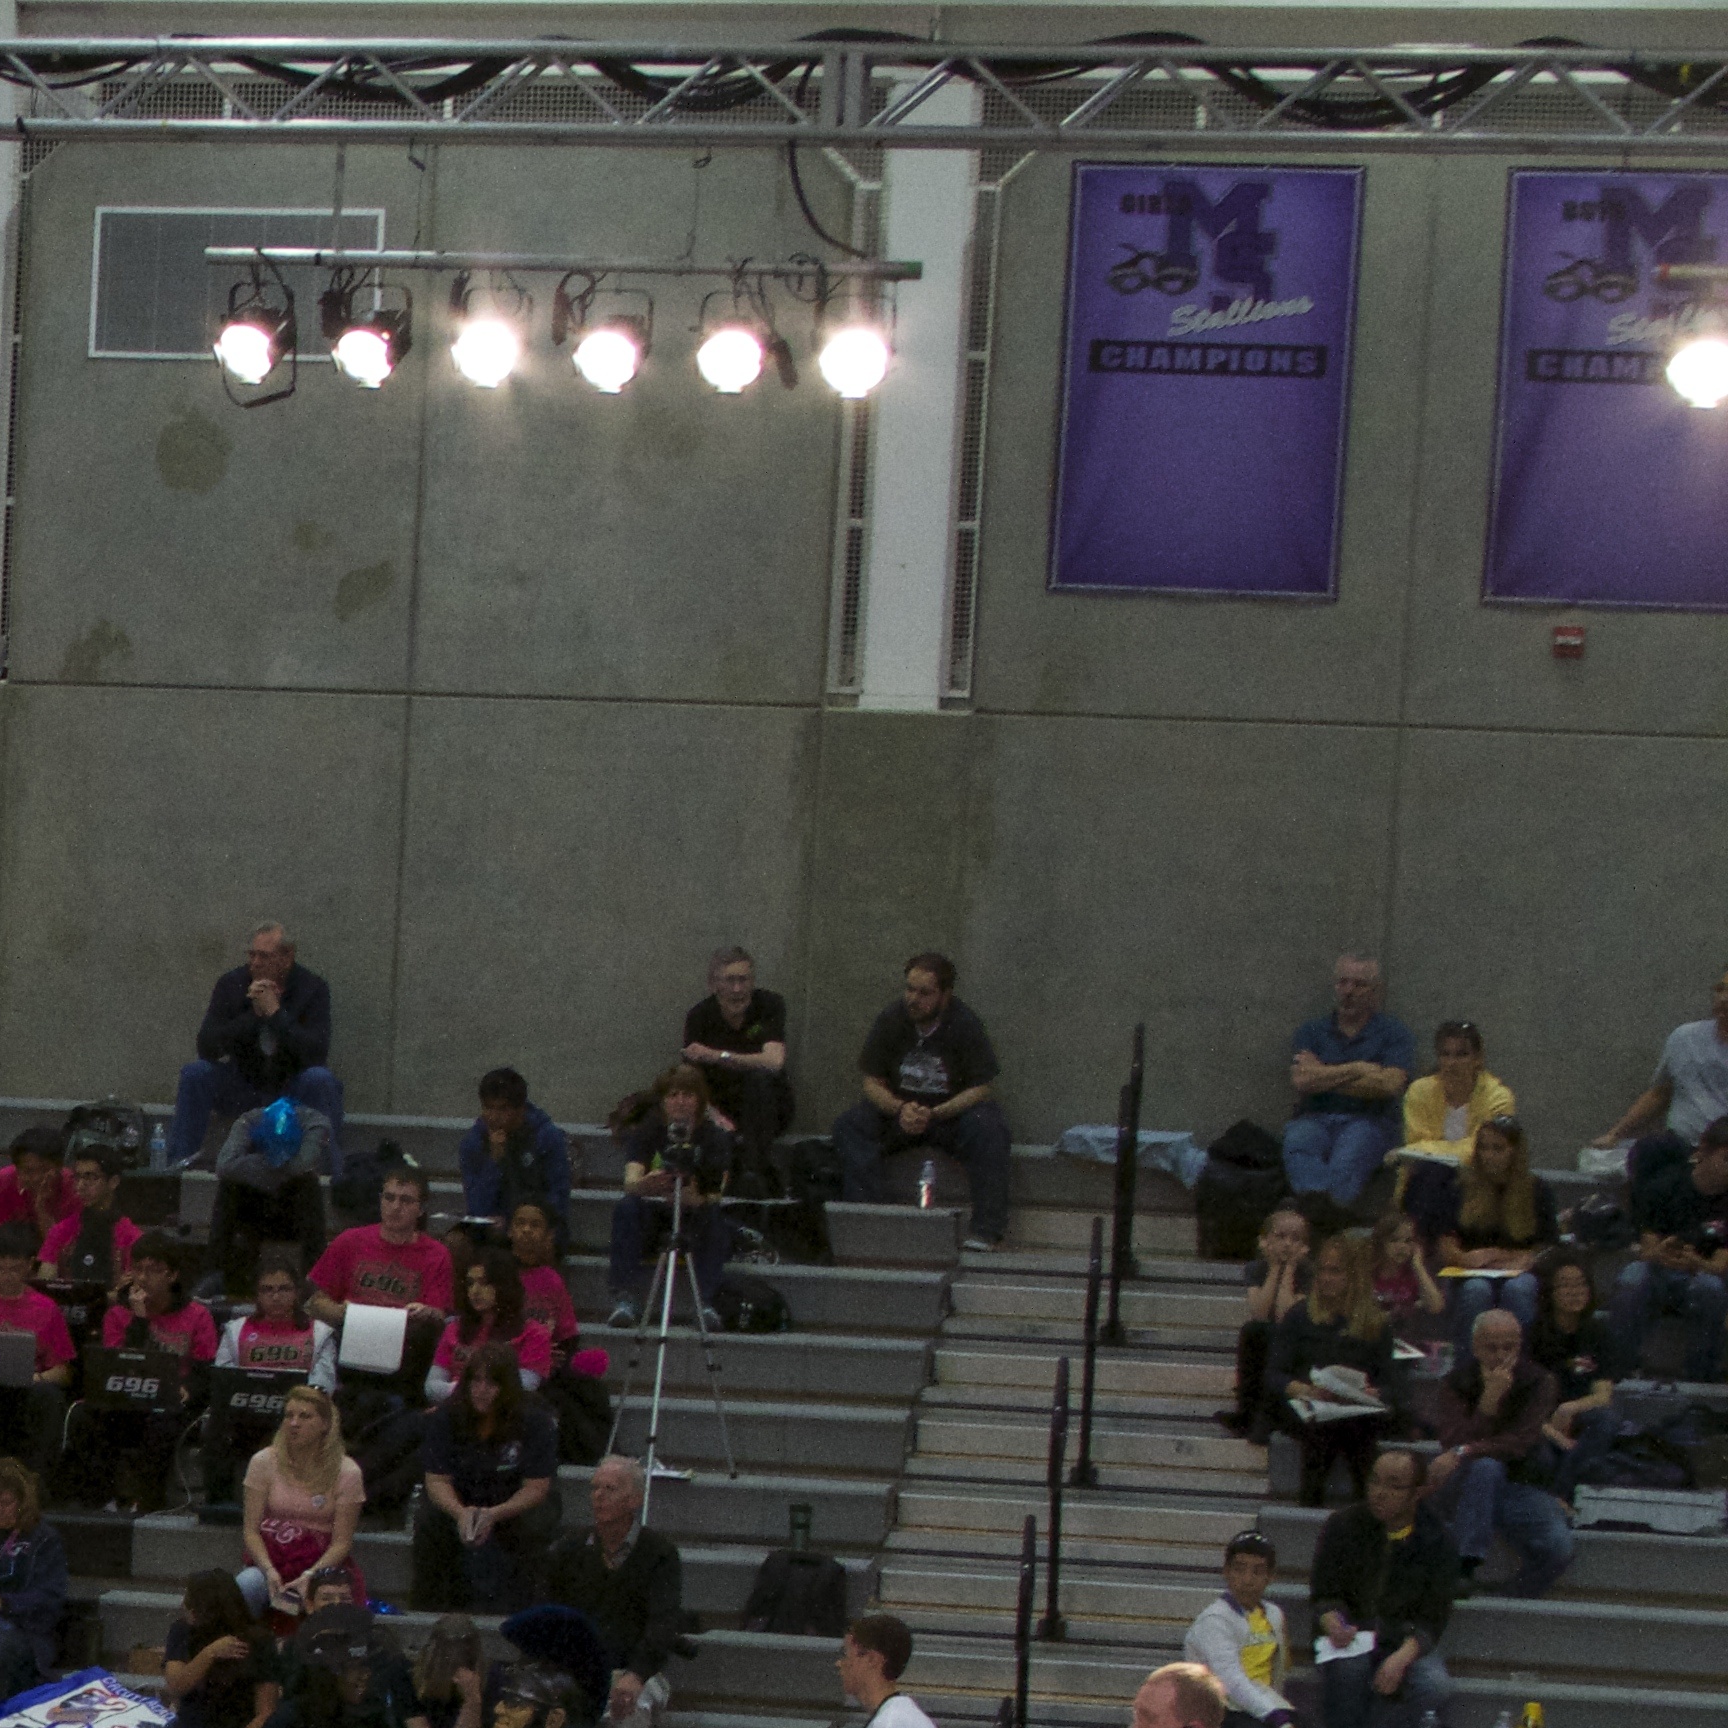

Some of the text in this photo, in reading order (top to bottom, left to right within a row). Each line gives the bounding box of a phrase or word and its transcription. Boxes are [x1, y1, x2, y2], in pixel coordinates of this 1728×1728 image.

[1167, 296, 1314, 337] Stallions
[1100, 346, 1318, 373] CHAMPIONS
[251, 1346, 298, 1361] 696
[105, 1376, 161, 1393] 696
[230, 1392, 286, 1409] 696
